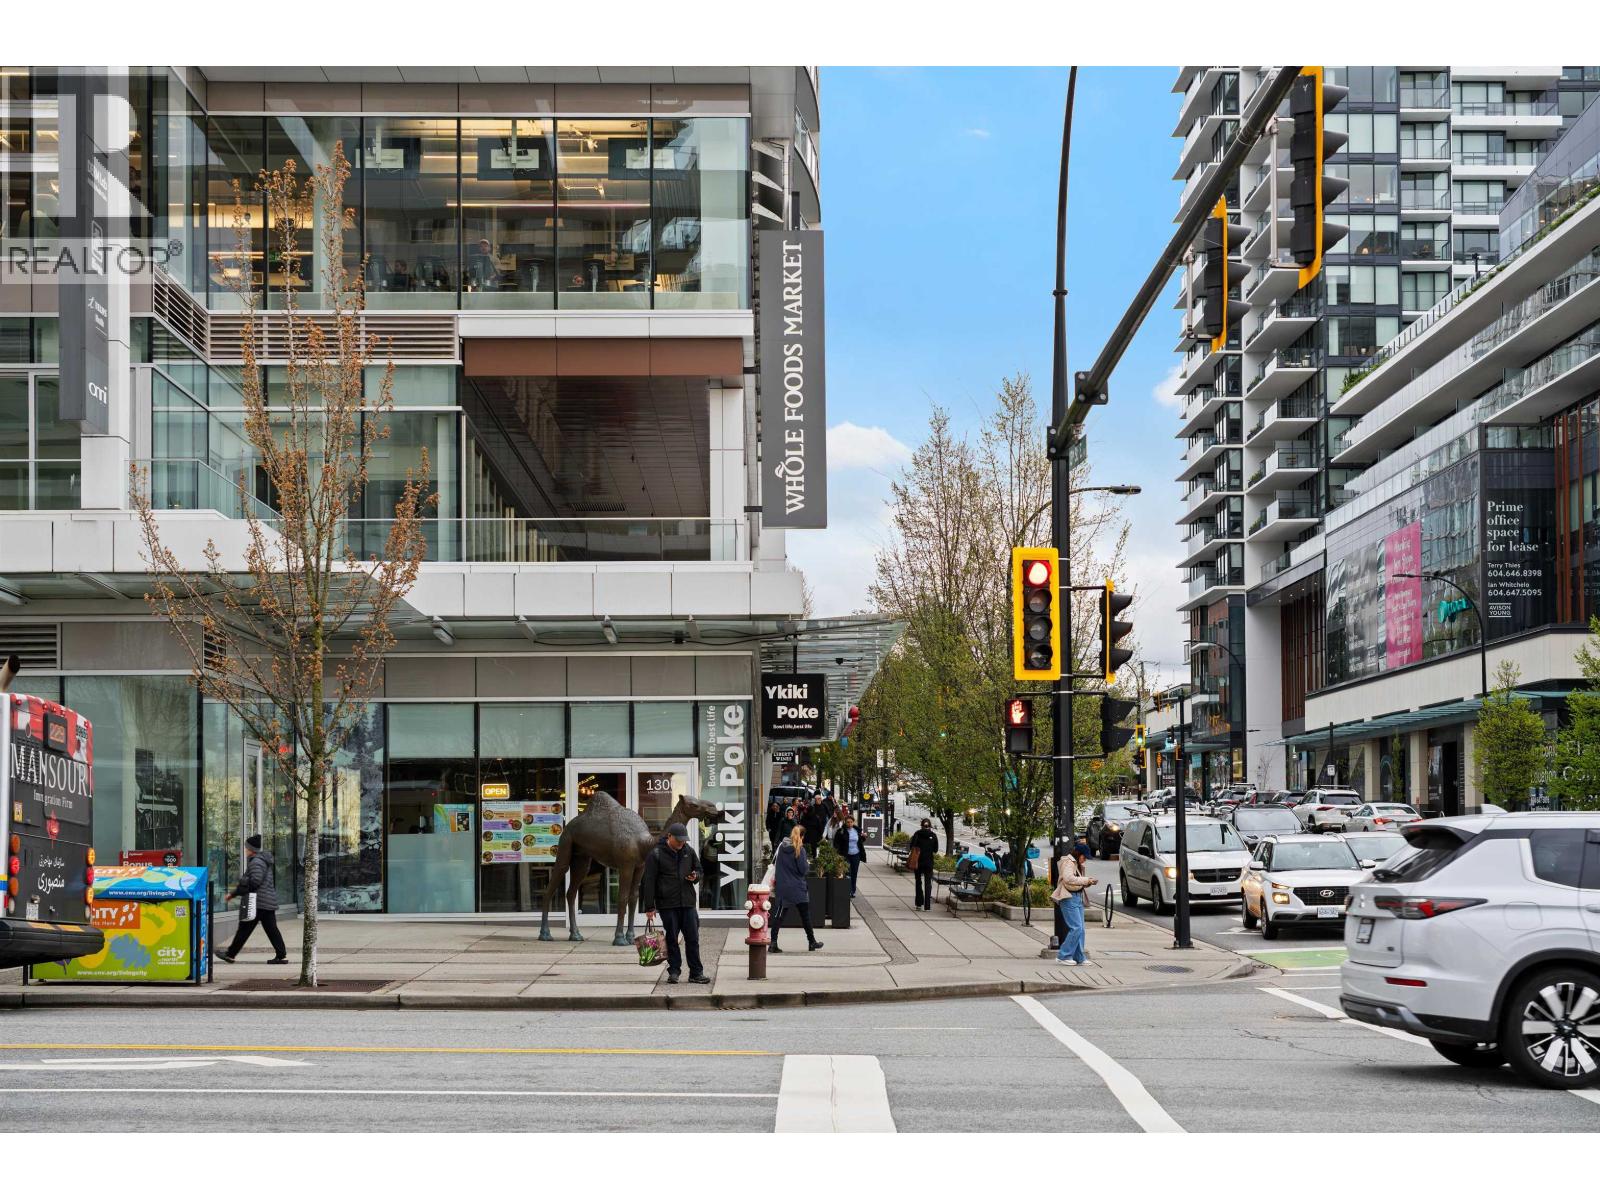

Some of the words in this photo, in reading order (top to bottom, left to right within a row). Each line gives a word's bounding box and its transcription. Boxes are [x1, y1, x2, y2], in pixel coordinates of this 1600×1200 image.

[782, 240, 803, 336] MARKET
[783, 343, 804, 422] FOODS
[780, 429, 805, 515] WHOLE
[1487, 501, 1524, 512] Prime
[1486, 514, 1520, 526] office
[1486, 529, 1520, 541] space
[1487, 541, 1506, 552] for
[1509, 541, 1539, 552] lease
[1487, 562, 1503, 570] Terry
[1487, 569, 1543, 577] 604.646.8398
[765, 683, 809, 699] Ykiki
[706, 705, 716, 721] life
[776, 704, 819, 719] Poke
[717, 704, 745, 787] Poke
[10, 742, 93, 798] MANSOURI
[707, 763, 716, 787] Bowl
[715, 802, 745, 888] Ykiki
[157, 947, 186, 958] city
